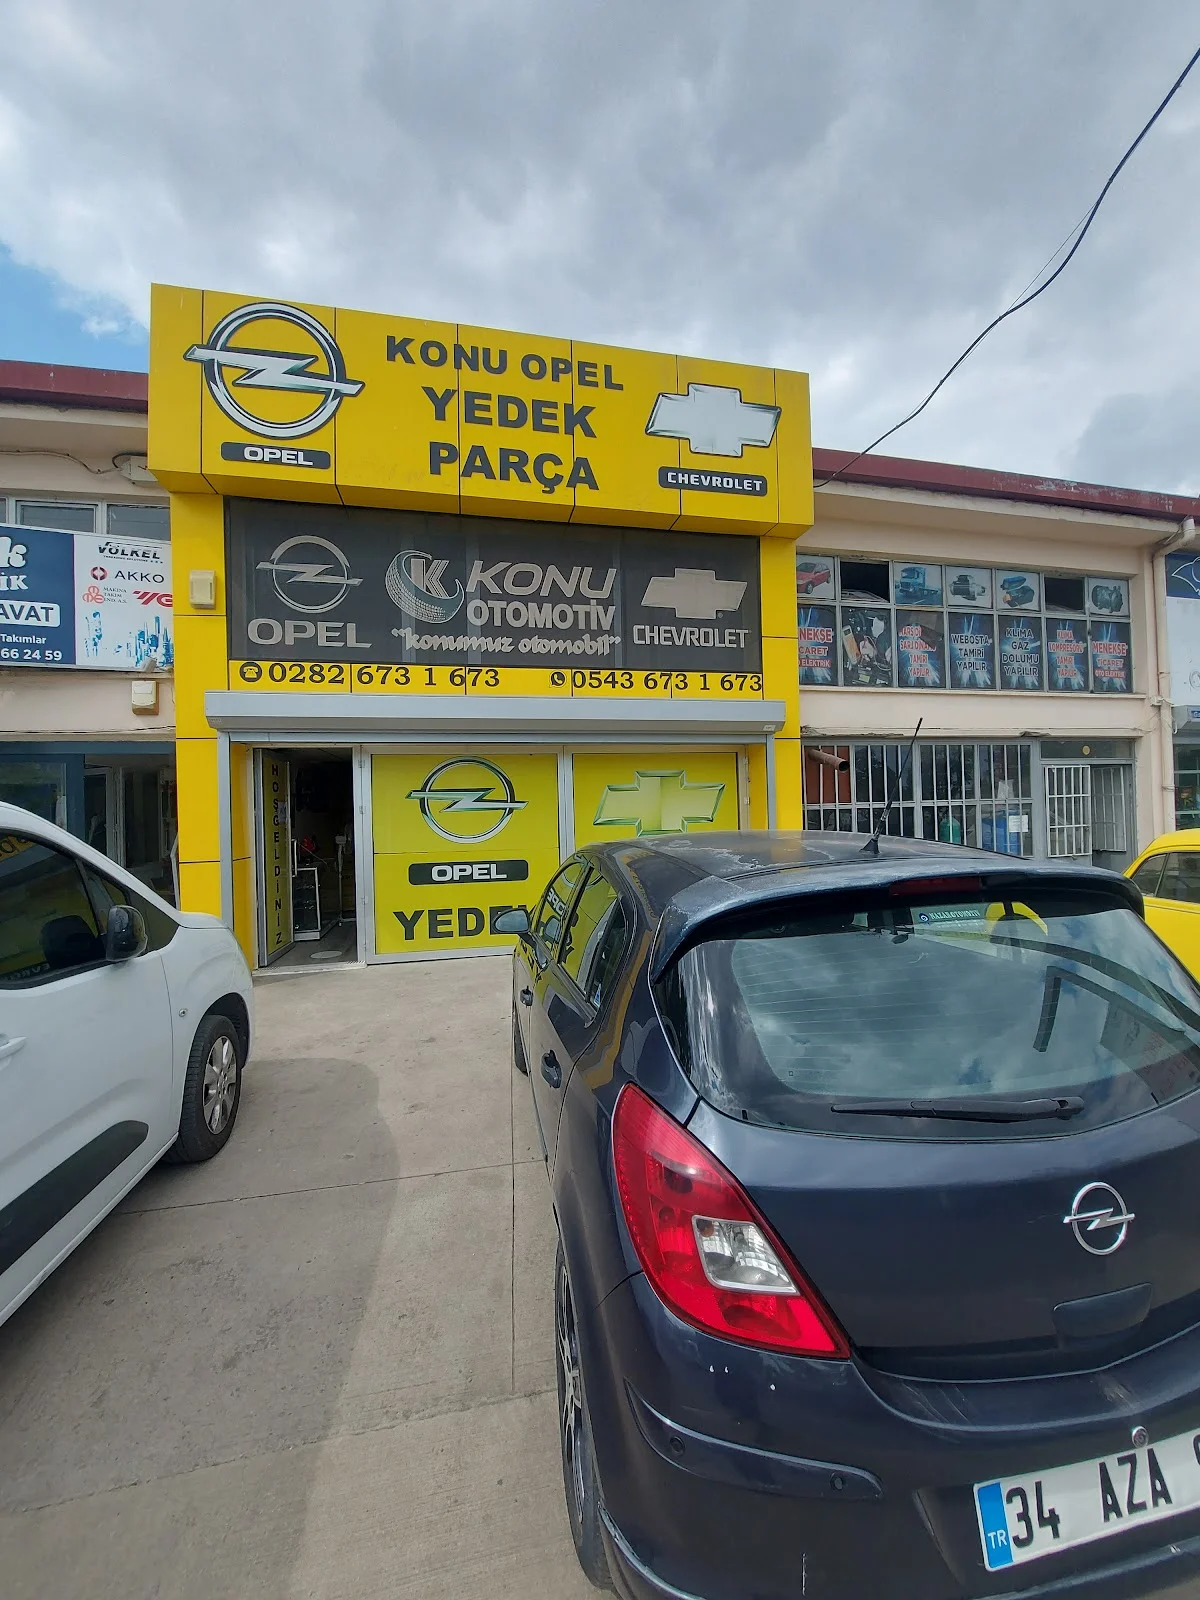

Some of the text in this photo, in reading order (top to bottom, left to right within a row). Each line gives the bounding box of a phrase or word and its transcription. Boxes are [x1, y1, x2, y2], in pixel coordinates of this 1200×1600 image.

[386, 335, 624, 391] KONU OPEL
[421, 386, 598, 438] YEDEK
[243, 446, 314, 466] OPEL
[429, 441, 600, 494] PARÇA
[667, 471, 762, 491] CHEVROLET
[98, 544, 161, 560] VÖLKEL
[115, 570, 165, 584] AKKO
[465, 560, 617, 599] KONU
[466, 598, 616, 631] OTOMOTİV
[0, 633, 47, 645] Takımlar
[248, 618, 372, 649] OPEL
[632, 624, 749, 648] CHEVROLET
[798, 627, 832, 643] NEKŞE
[951, 634, 990, 645] WEBOSTA
[1006, 628, 1034, 639] KLİMA
[1, 648, 62, 661] 66 24 59
[959, 648, 984, 658] TAMİRİ
[1011, 641, 1030, 651] GAZ
[957, 661, 987, 671] YAPILIR
[1002, 653, 1040, 664] DOLUMU
[268, 662, 500, 688] 0282 673 1 673
[572, 670, 762, 692] 0543 673 1 673
[1004, 666, 1039, 676] YAPILIR
[431, 863, 507, 882] OPEL
[392, 904, 537, 941] YEDE
[1005, 1480, 1061, 1549] 34
[1098, 1447, 1173, 1523] AZA
[987, 1529, 1008, 1549] TR
